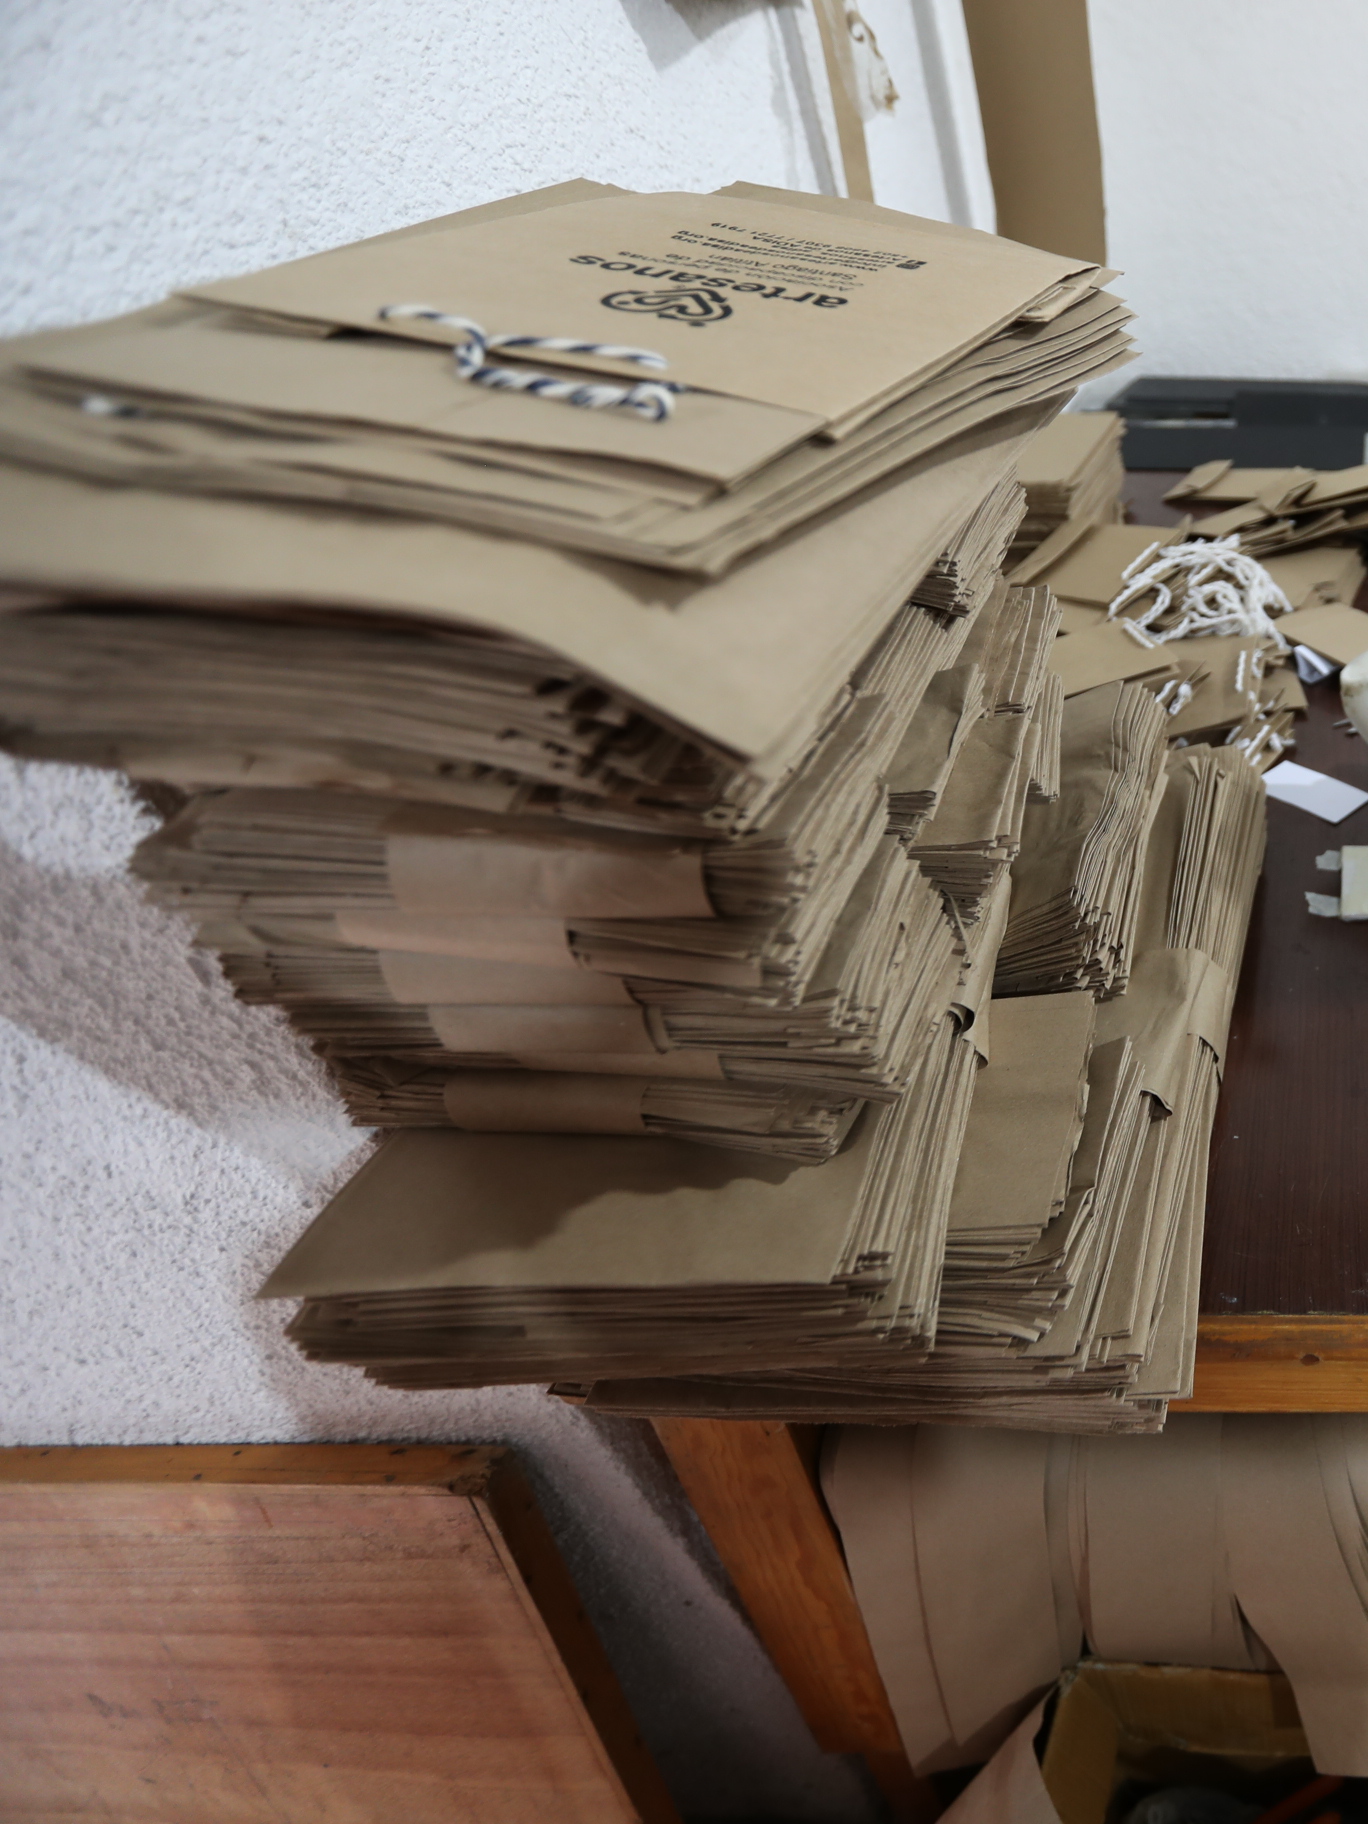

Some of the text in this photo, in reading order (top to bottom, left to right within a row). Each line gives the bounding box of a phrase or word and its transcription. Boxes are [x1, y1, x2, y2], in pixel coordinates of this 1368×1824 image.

[709, 222, 747, 233] 7919
[750, 236, 801, 247] ADISA
[664, 253, 692, 261] de
[772, 263, 858, 280] Santiago
[569, 254, 849, 308] artesanos
